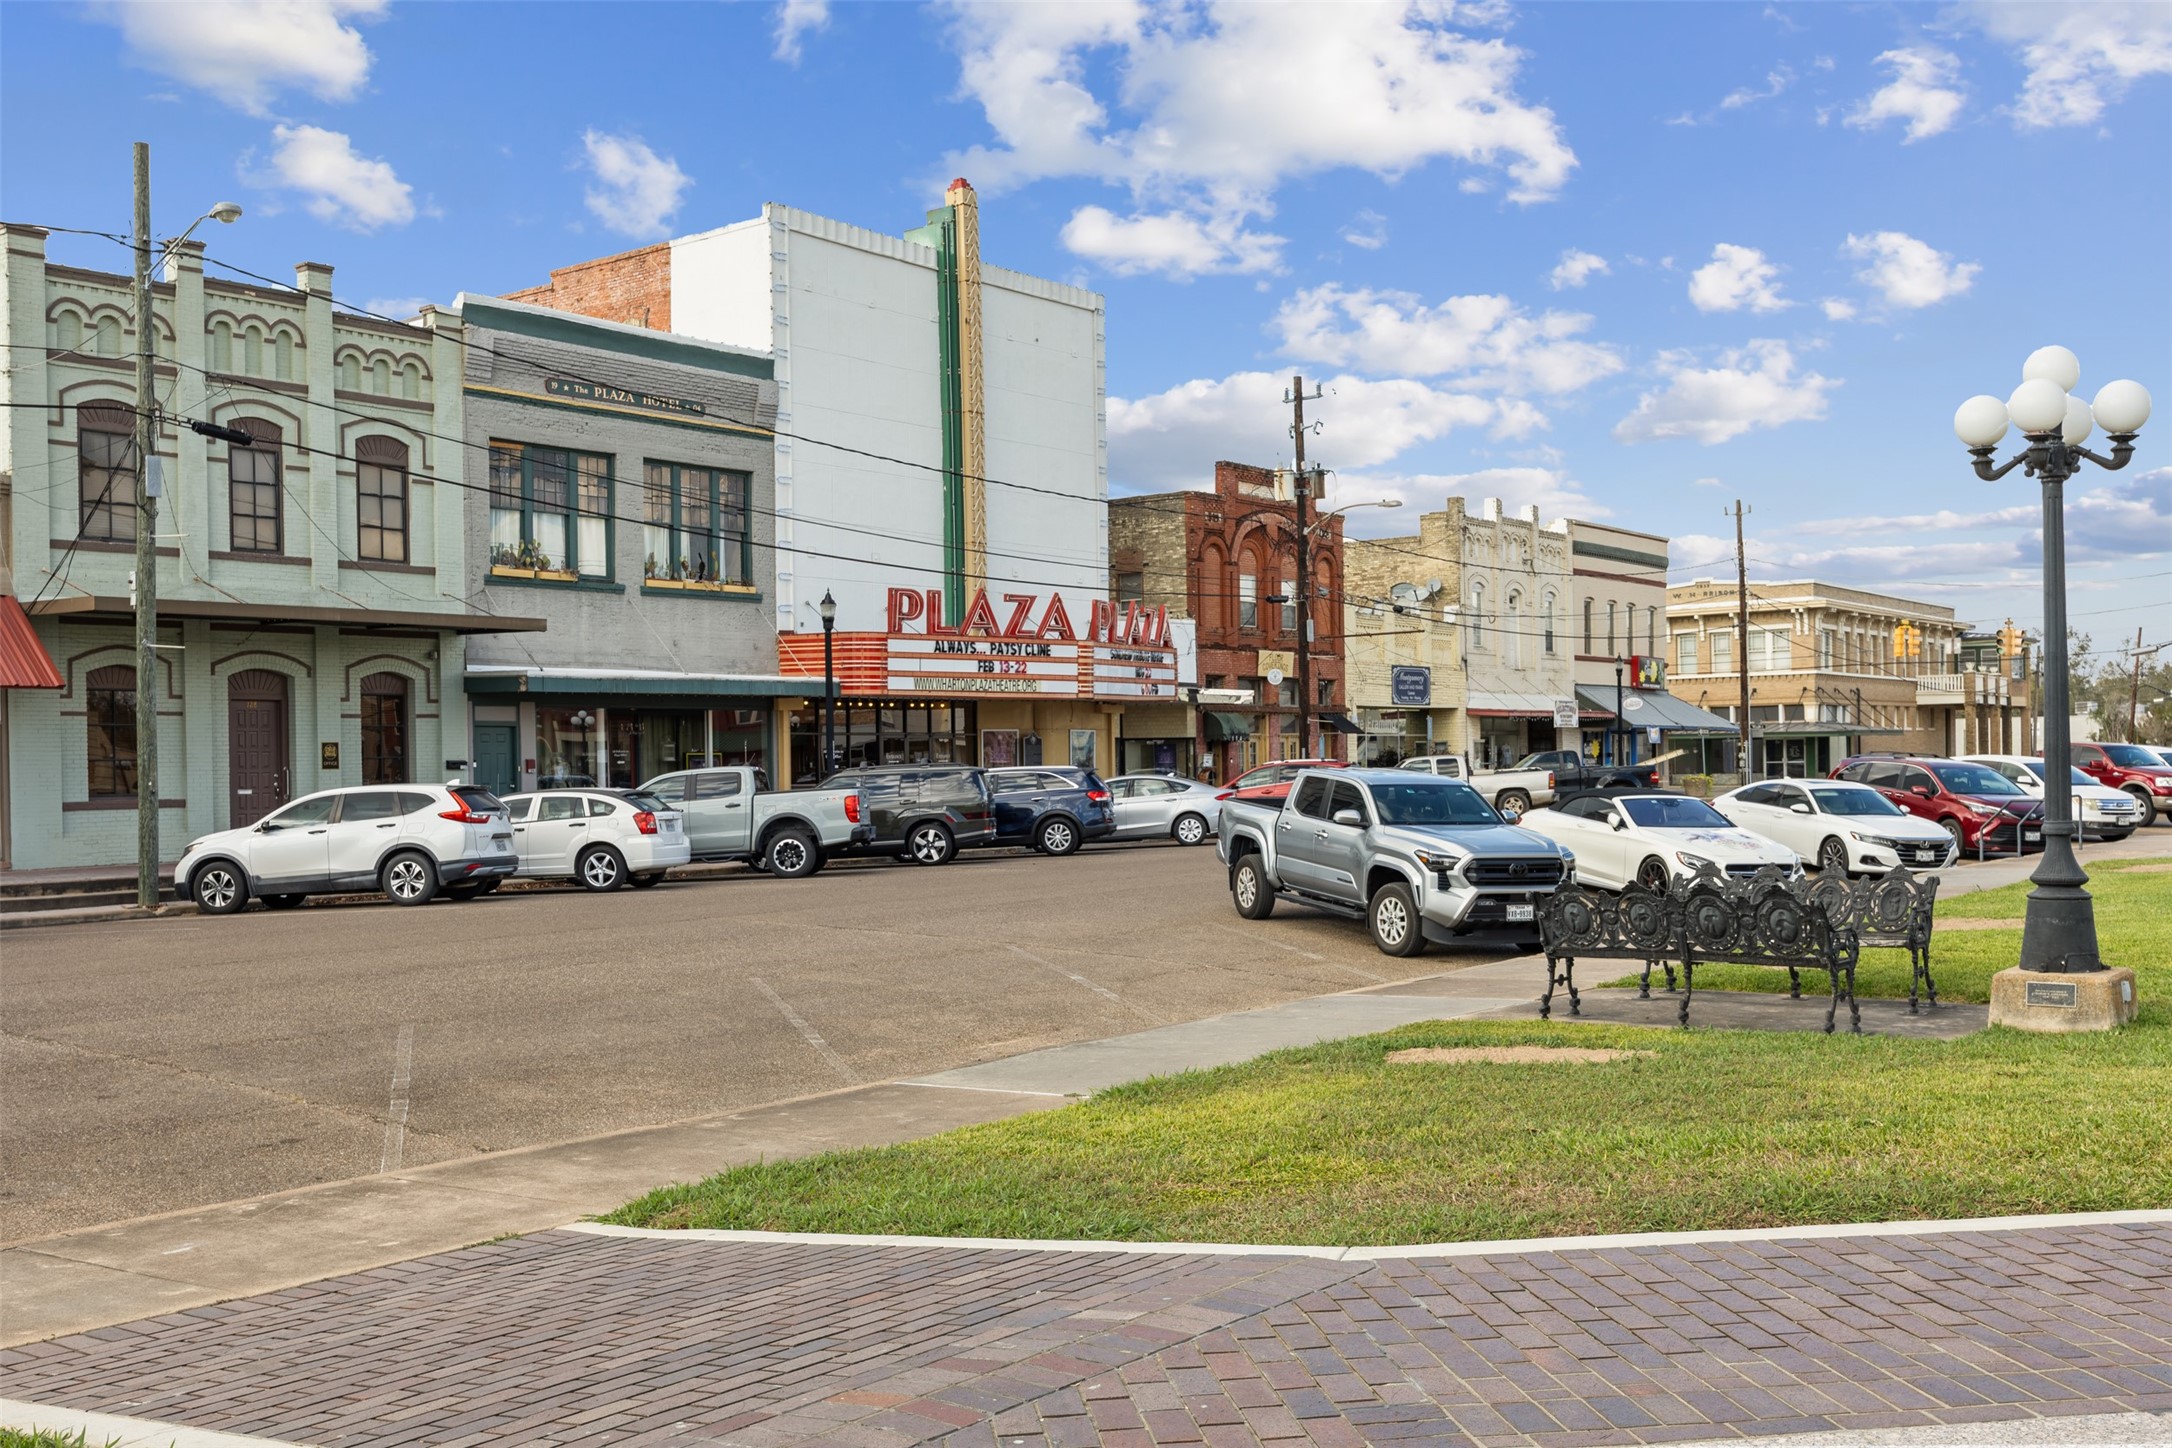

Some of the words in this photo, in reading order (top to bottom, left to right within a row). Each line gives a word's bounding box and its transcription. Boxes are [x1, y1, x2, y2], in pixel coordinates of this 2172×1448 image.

[551, 381, 559, 390] 19
[574, 385, 588, 394] The
[594, 387, 635, 403] PLAZA
[643, 396, 682, 410] HOTEL
[888, 587, 1076, 640] PLAZA
[1086, 599, 1174, 648] PLAZA
[934, 640, 986, 655] ALWAYS...
[990, 642, 1023, 655] PATSY
[1025, 643, 1051, 657] CLINE
[978, 661, 994, 672] FEB
[1000, 661, 1027, 674] 13-22
[914, 678, 1037, 692] WWW.WHARTONPLAZATHEATRE.ORG
